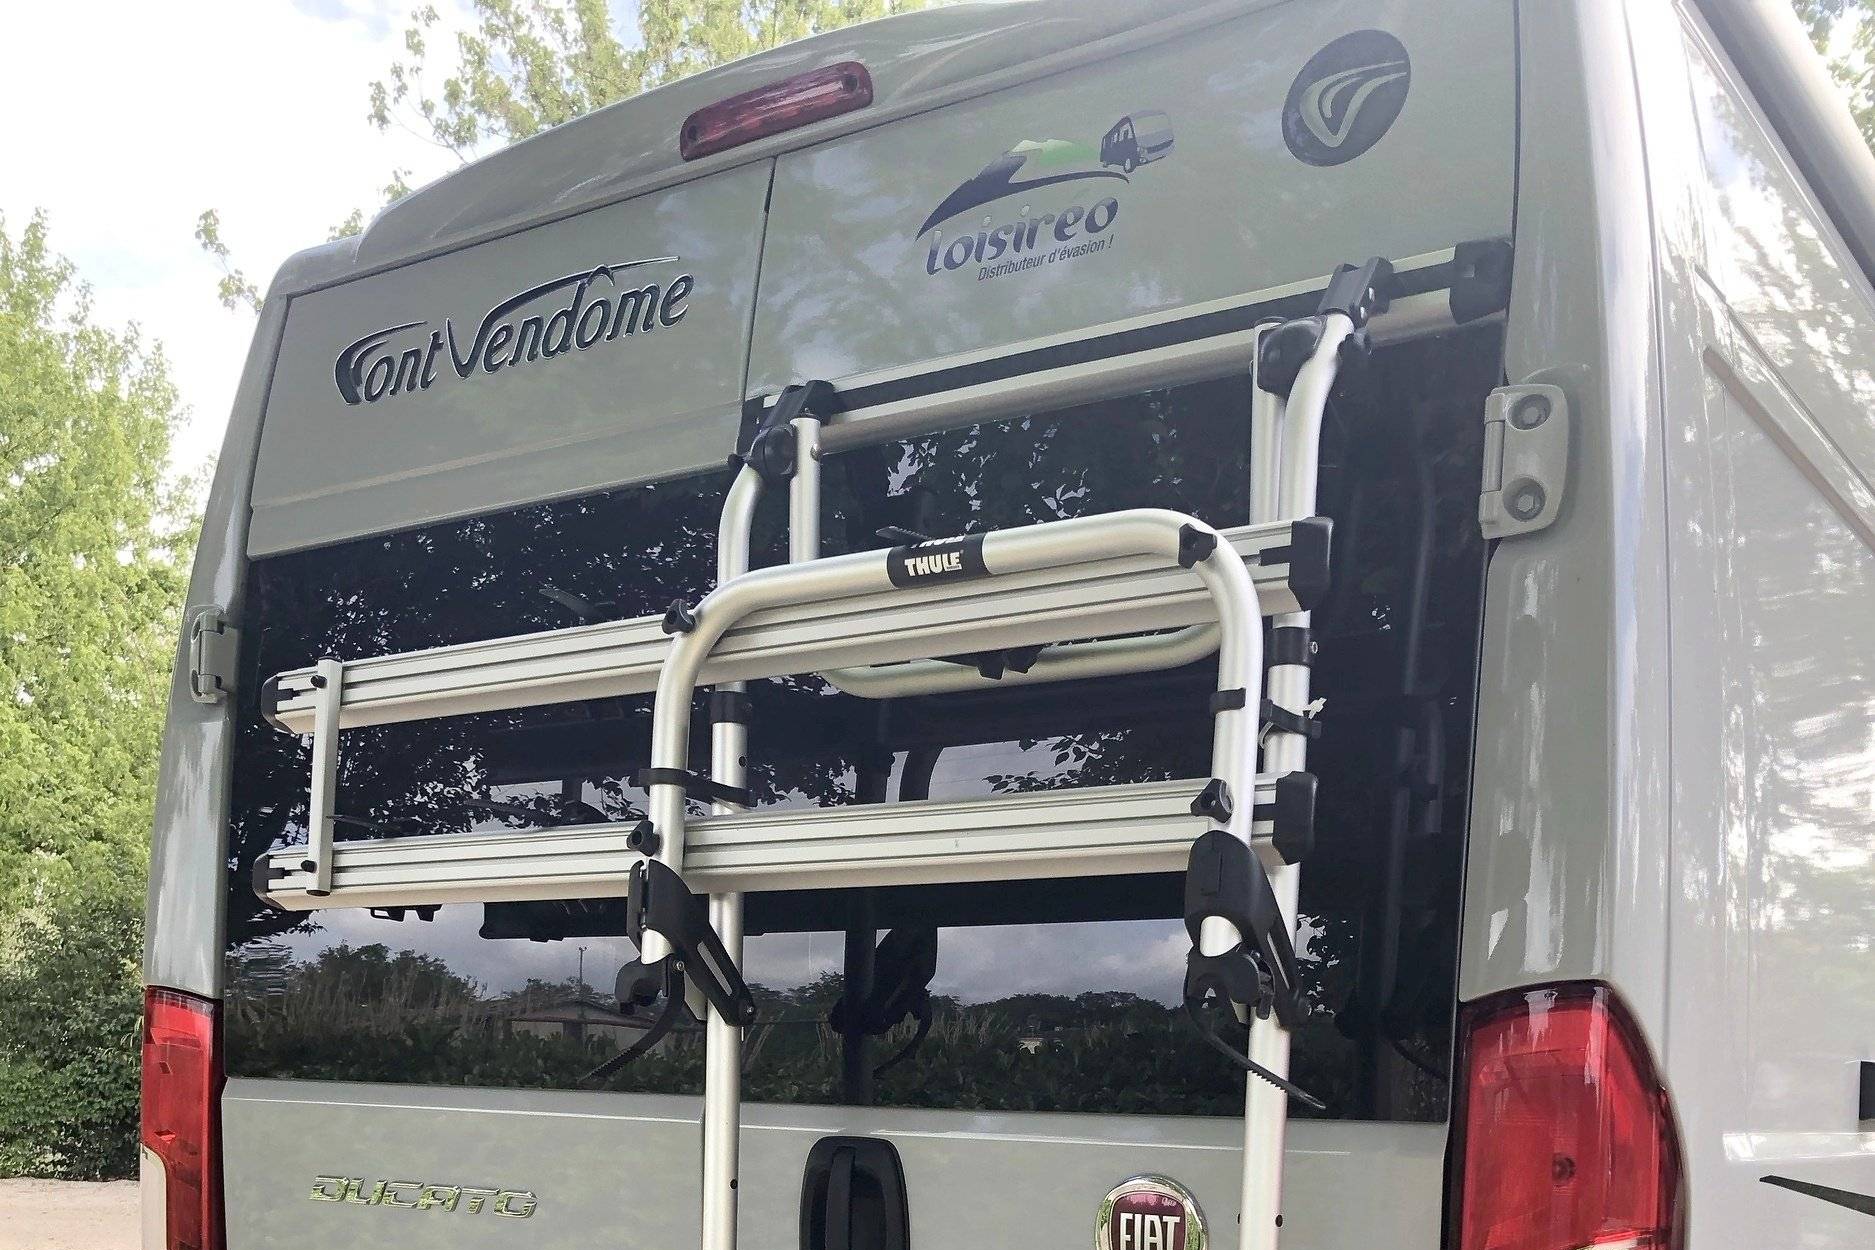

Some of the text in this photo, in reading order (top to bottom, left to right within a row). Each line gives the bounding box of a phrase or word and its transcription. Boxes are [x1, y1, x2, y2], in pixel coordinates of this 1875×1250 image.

[978, 254, 1047, 281] Distributeur
[904, 551, 962, 577] THULE
[310, 1175, 537, 1218] DUCATO
